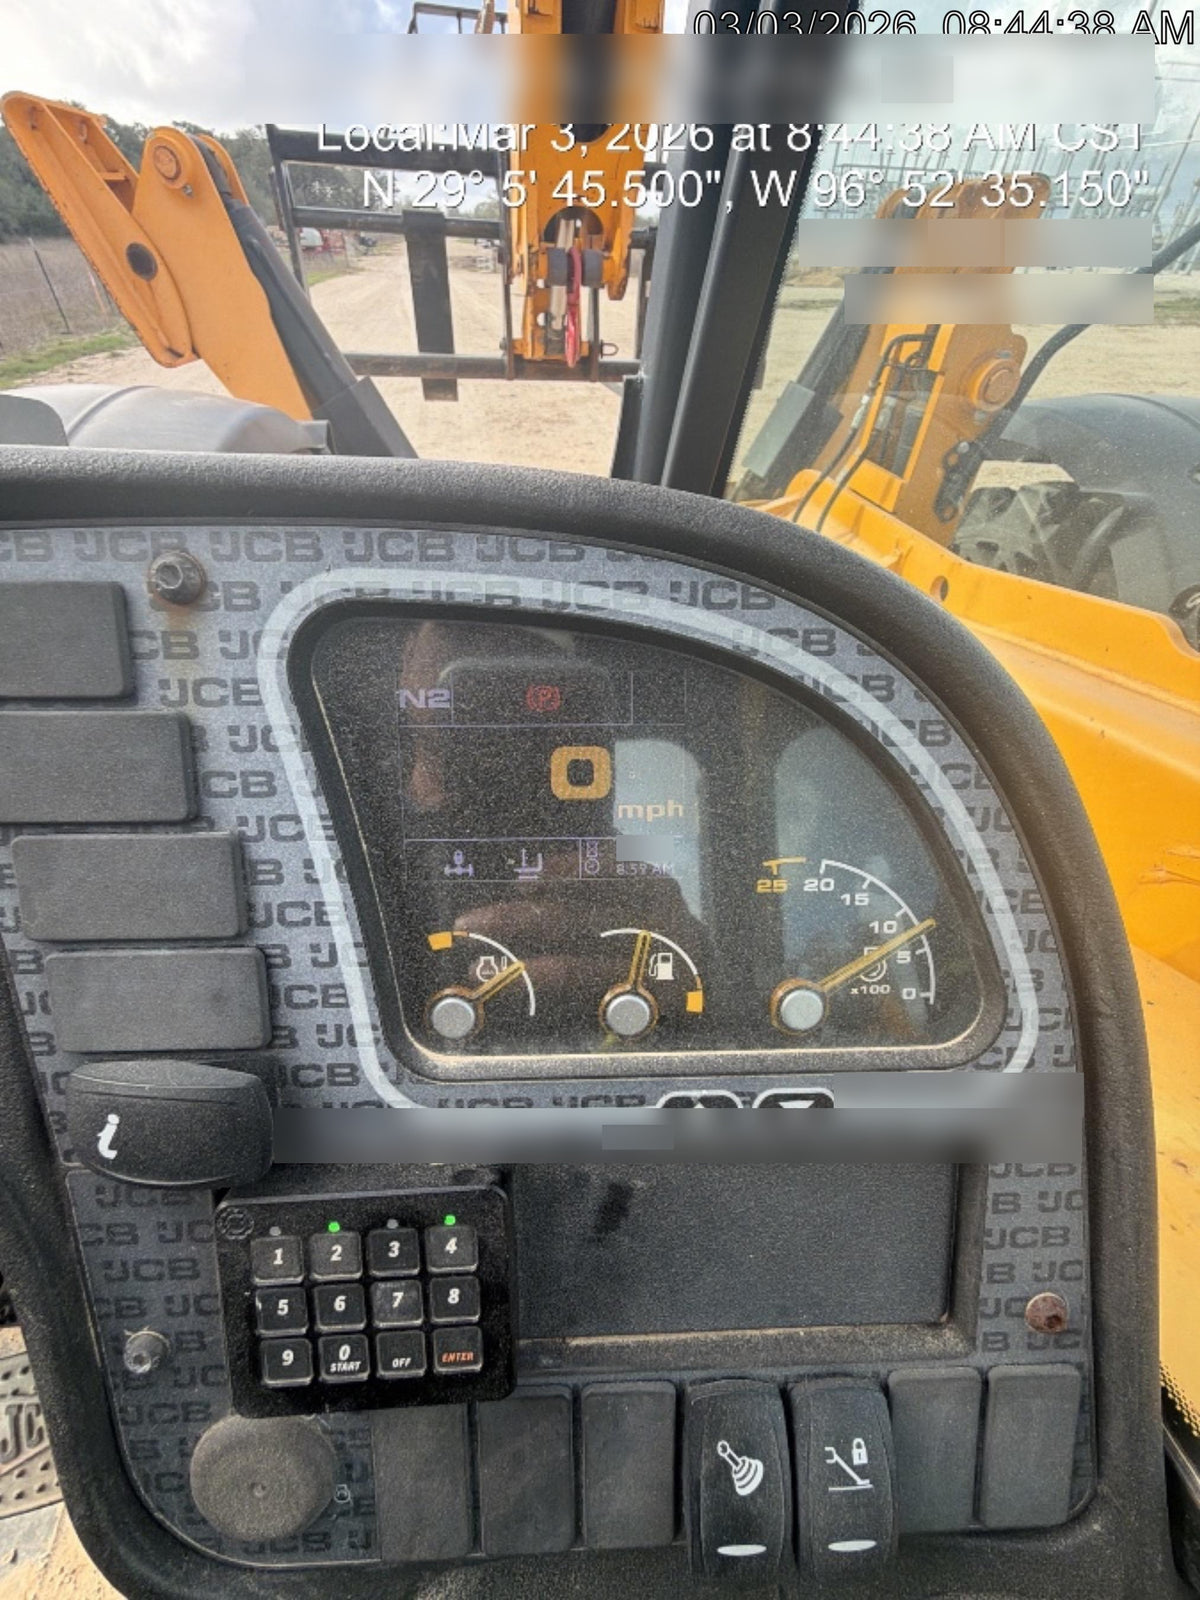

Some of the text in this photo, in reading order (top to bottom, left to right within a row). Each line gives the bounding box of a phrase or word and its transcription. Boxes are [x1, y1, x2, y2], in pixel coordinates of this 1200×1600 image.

[209, 531, 324, 562] JCB
[341, 531, 455, 562] JCB
[476, 535, 585, 562] JCB
[130, 630, 199, 660] CB
[399, 688, 451, 709] N2
[201, 770, 278, 799] CB
[617, 801, 684, 822] mph
[756, 878, 789, 894] 25
[803, 878, 835, 892] 20
[840, 893, 870, 906] 15
[869, 920, 898, 934] 10
[896, 950, 912, 965] 5
[850, 984, 891, 995] x100
[902, 987, 917, 1001] 0
[316, 1023, 381, 1048] JC
[279, 1062, 361, 1088] CB
[1038, 1190, 1083, 1213] JC
[80, 1220, 214, 1246] CB JC
[984, 1226, 1070, 1250] JCB
[273, 1237, 458, 1265] 1 2 3 4
[103, 1258, 200, 1282] JCB
[1032, 1260, 1083, 1282] JC
[164, 1294, 219, 1317] JC
[277, 1288, 460, 1316] 5 6 7 8
[281, 1344, 351, 1366] 9 0
[330, 1351, 475, 1373] START OFF ENTER
